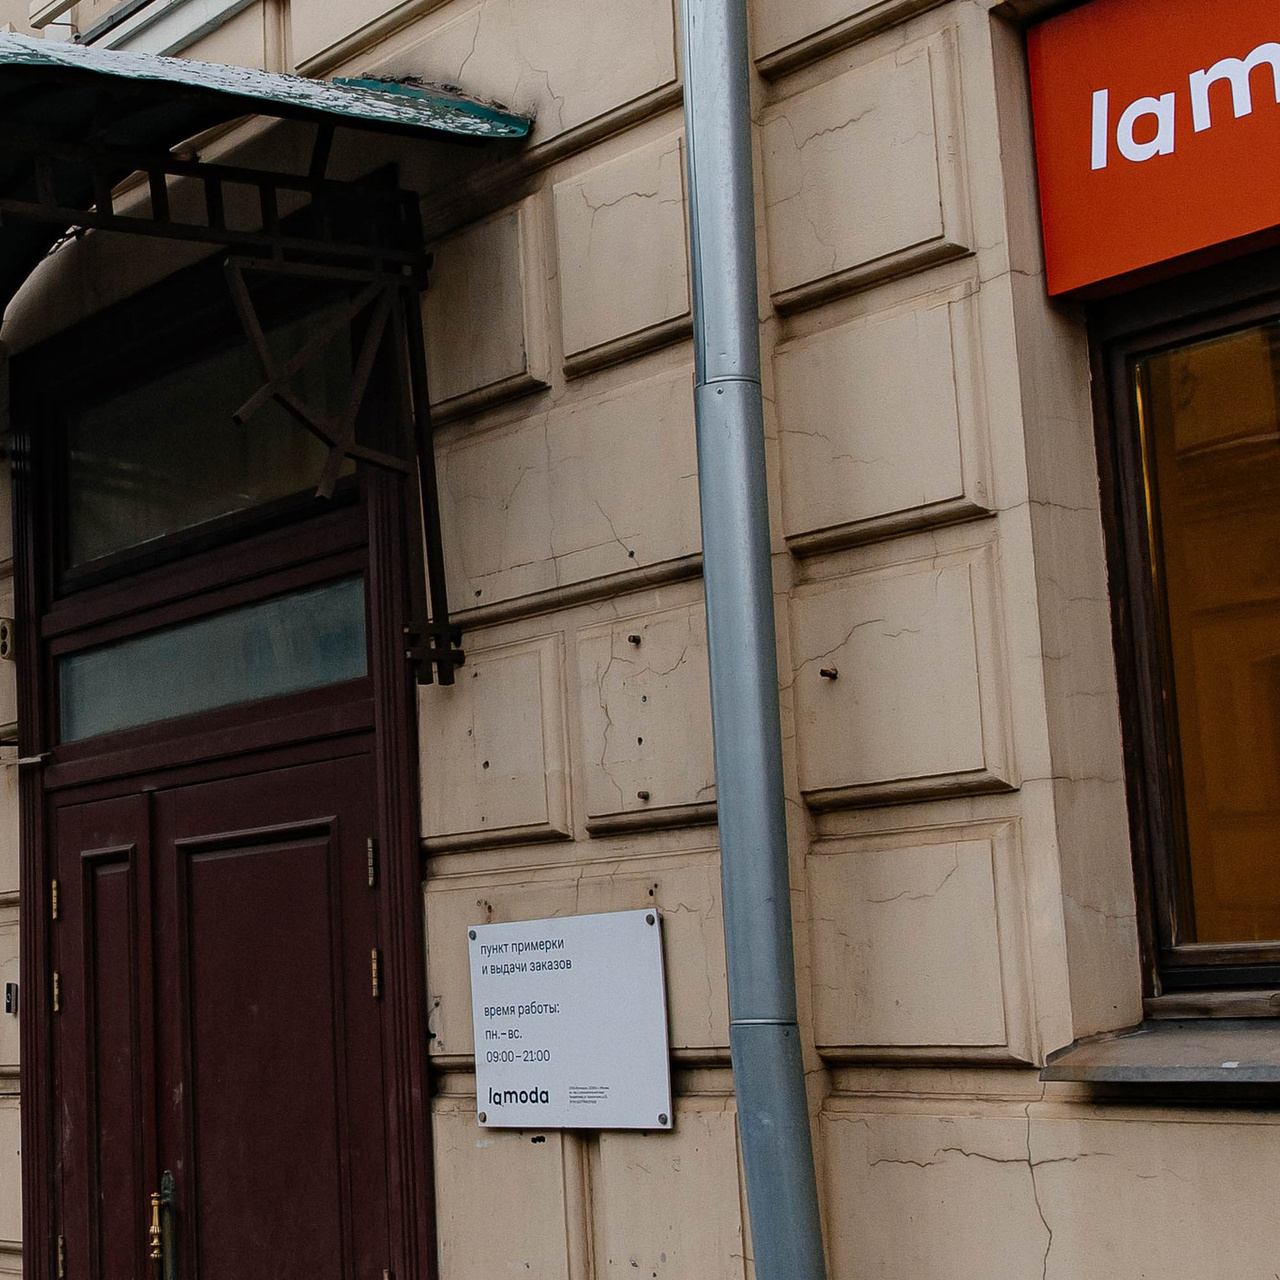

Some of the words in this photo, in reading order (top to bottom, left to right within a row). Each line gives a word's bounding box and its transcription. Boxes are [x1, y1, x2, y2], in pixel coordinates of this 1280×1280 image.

[480, 943, 509, 958] пункт
[511, 939, 565, 955] примерки
[482, 965, 488, 974] и
[490, 962, 527, 975] выдачи
[529, 959, 572, 972] заказов
[484, 1005, 516, 1019] время
[518, 1001, 560, 1018] работы:
[489, 1086, 549, 1106] lamoda
